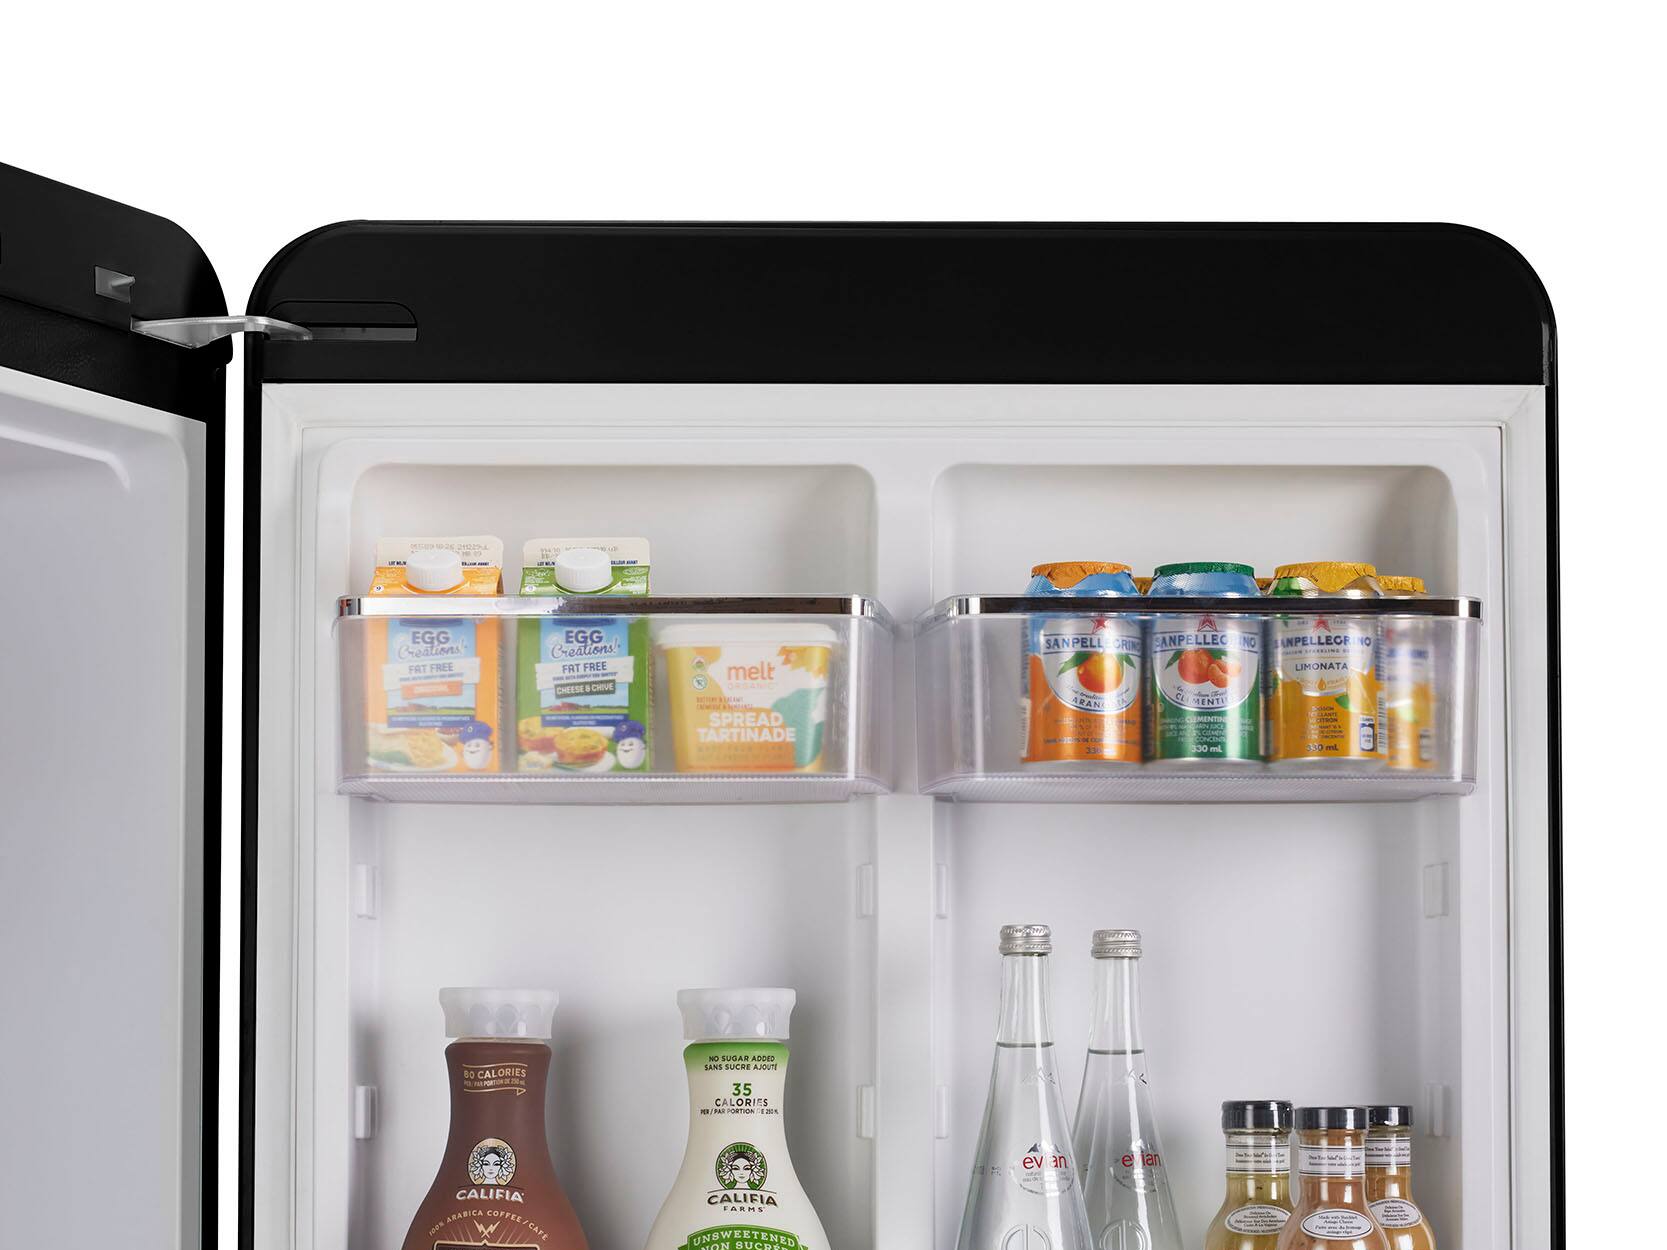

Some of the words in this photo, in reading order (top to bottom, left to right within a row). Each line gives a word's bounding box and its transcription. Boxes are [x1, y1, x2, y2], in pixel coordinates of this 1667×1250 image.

[411, 630, 450, 645] EGG
[565, 630, 603, 645] EGG
[398, 638, 464, 659] Creations!
[551, 638, 617, 659] Creations!
[408, 664, 427, 674] FAT
[430, 662, 454, 672] FREE
[562, 664, 580, 674] FAT
[584, 661, 607, 672] FREE
[727, 662, 776, 681] melt
[1295, 662, 1348, 671] LIMONATA
[557, 685, 584, 694] CHEESE
[591, 683, 614, 692] CHIVE
[710, 712, 783, 727] SPREAD
[696, 727, 796, 743] TARTINADE
[1192, 745, 1208, 753] 330
[477, 1068, 527, 1079] CALORIES
[732, 1083, 752, 1096] 35
[714, 1098, 768, 1107] CALORIES
[1022, 1154, 1067, 1169] evan
[456, 1188, 524, 1203] CALIFIA
[707, 1193, 778, 1208] CALIFIA
[446, 1210, 483, 1224] ARABICA
[487, 1210, 522, 1224] COFFEE
[693, 1230, 795, 1248] UNSWEETENED
